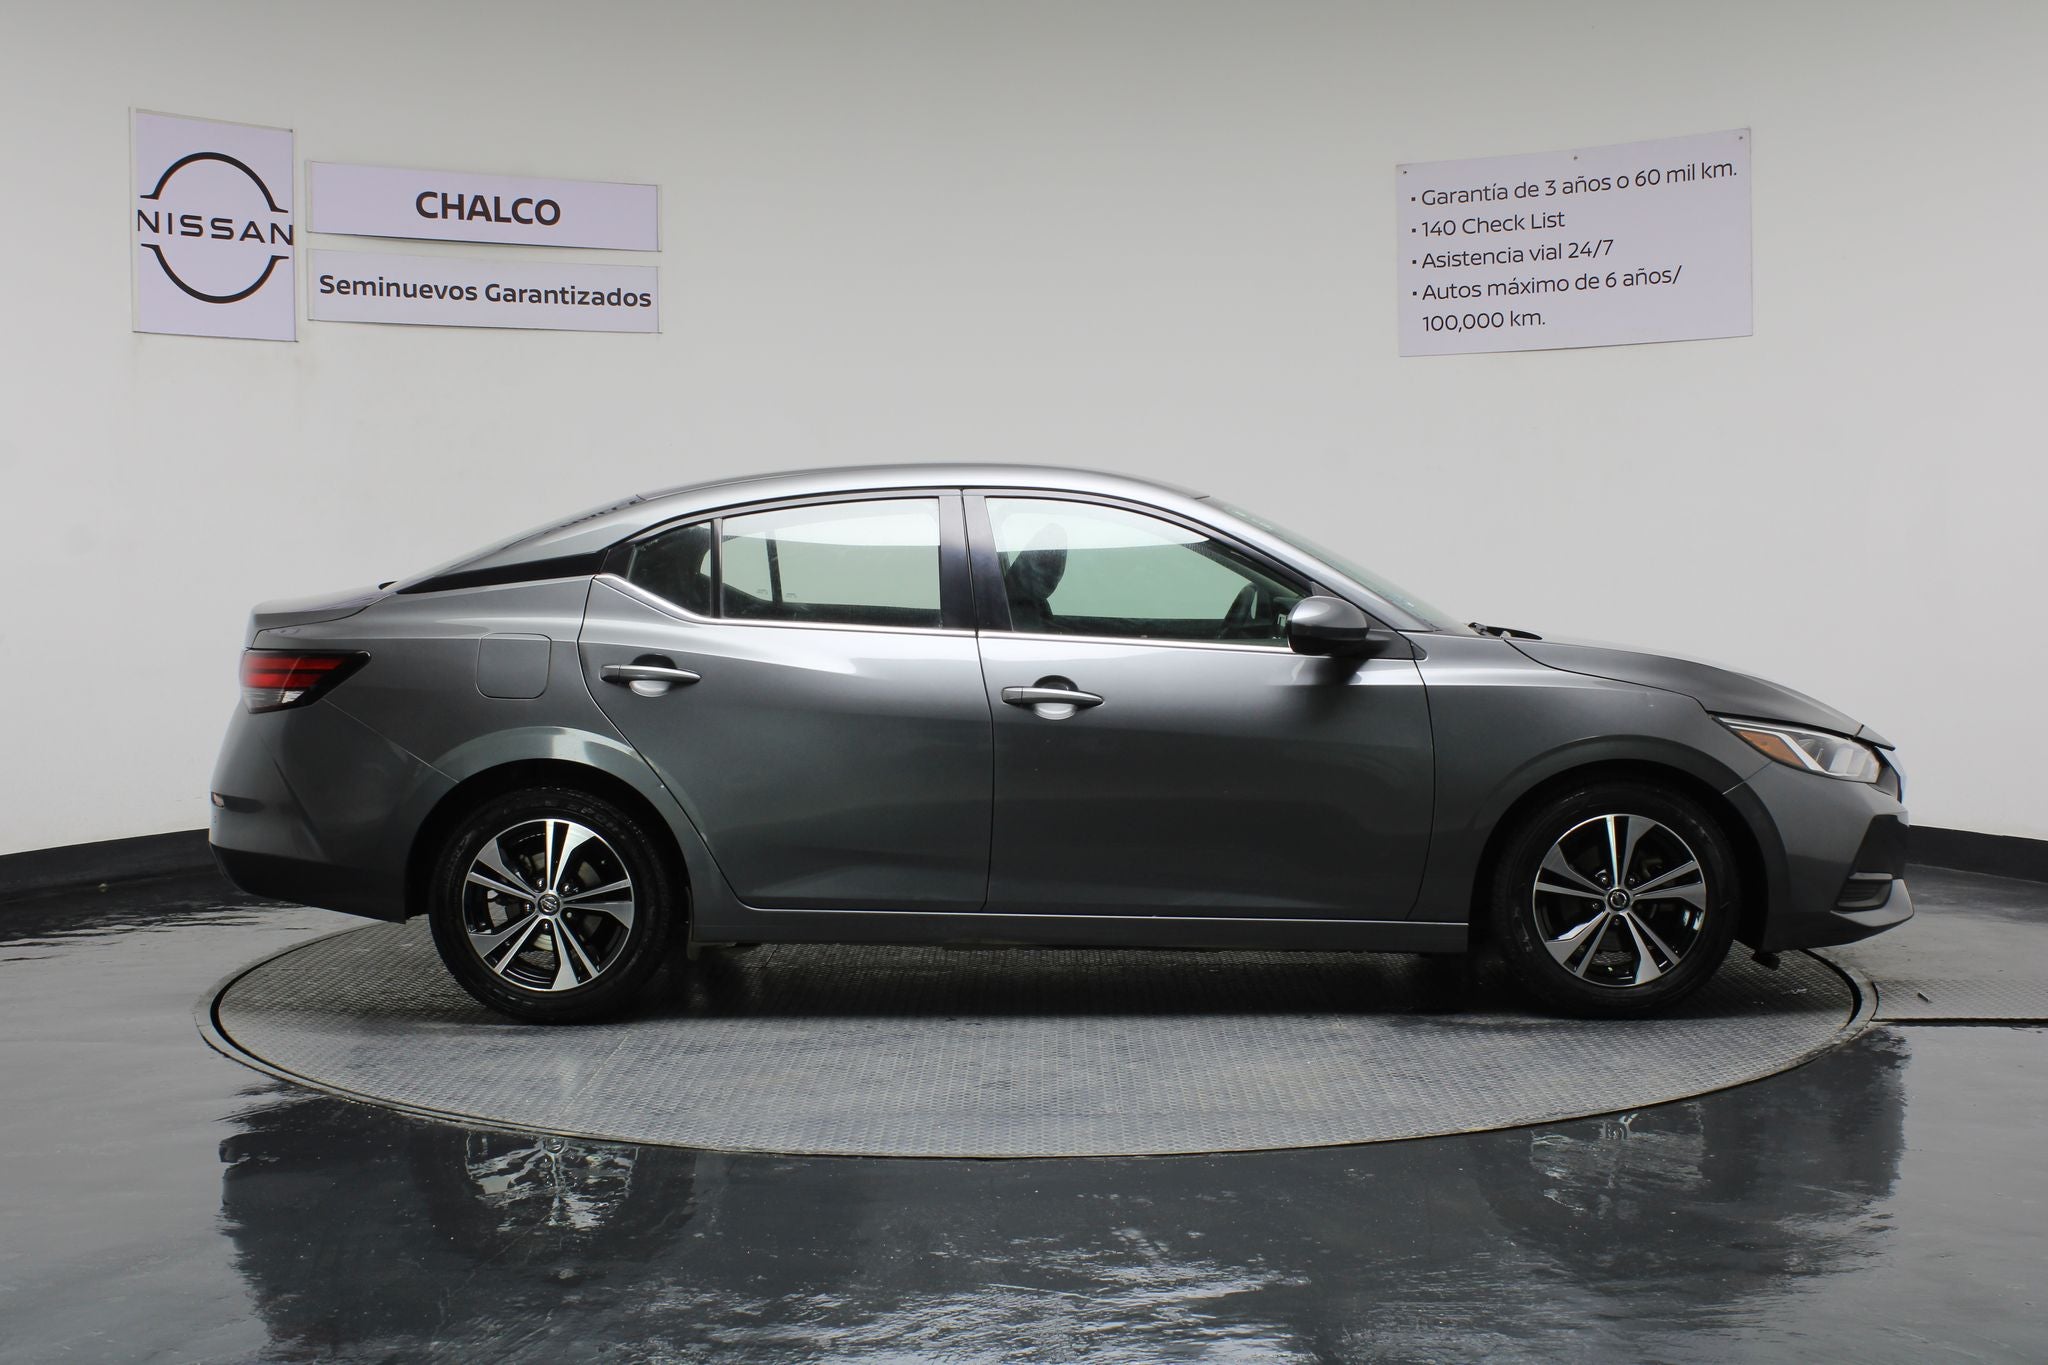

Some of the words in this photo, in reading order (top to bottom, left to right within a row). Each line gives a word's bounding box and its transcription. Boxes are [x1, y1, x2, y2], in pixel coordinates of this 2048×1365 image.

[1421, 182, 1509, 206] Garantía
[1513, 181, 1540, 199] de
[1544, 179, 1557, 197] 3
[1562, 175, 1612, 195] años
[1616, 175, 1630, 189] o
[1634, 168, 1661, 188] 60
[1666, 163, 1696, 184] mil
[1701, 161, 1737, 180] km.
[415, 191, 561, 226] CHALCO
[1421, 219, 1457, 238] 140
[1461, 214, 1526, 235] Check
[1531, 211, 1566, 230] List
[137, 209, 294, 246] NISSAN
[1421, 246, 1524, 269] Asistencia
[1528, 242, 1562, 262] vial
[1567, 239, 1614, 259] 24/7
[319, 274, 479, 302] Seminuevos
[484, 283, 652, 308] Garantizados
[1421, 283, 1482, 301] Autos
[1487, 276, 1570, 297] máximo
[1574, 271, 1600, 291] de
[1605, 271, 1617, 289] 6
[1622, 264, 1683, 287] años/
[1422, 312, 1505, 333] 100,000
[1510, 310, 1546, 327] km.
